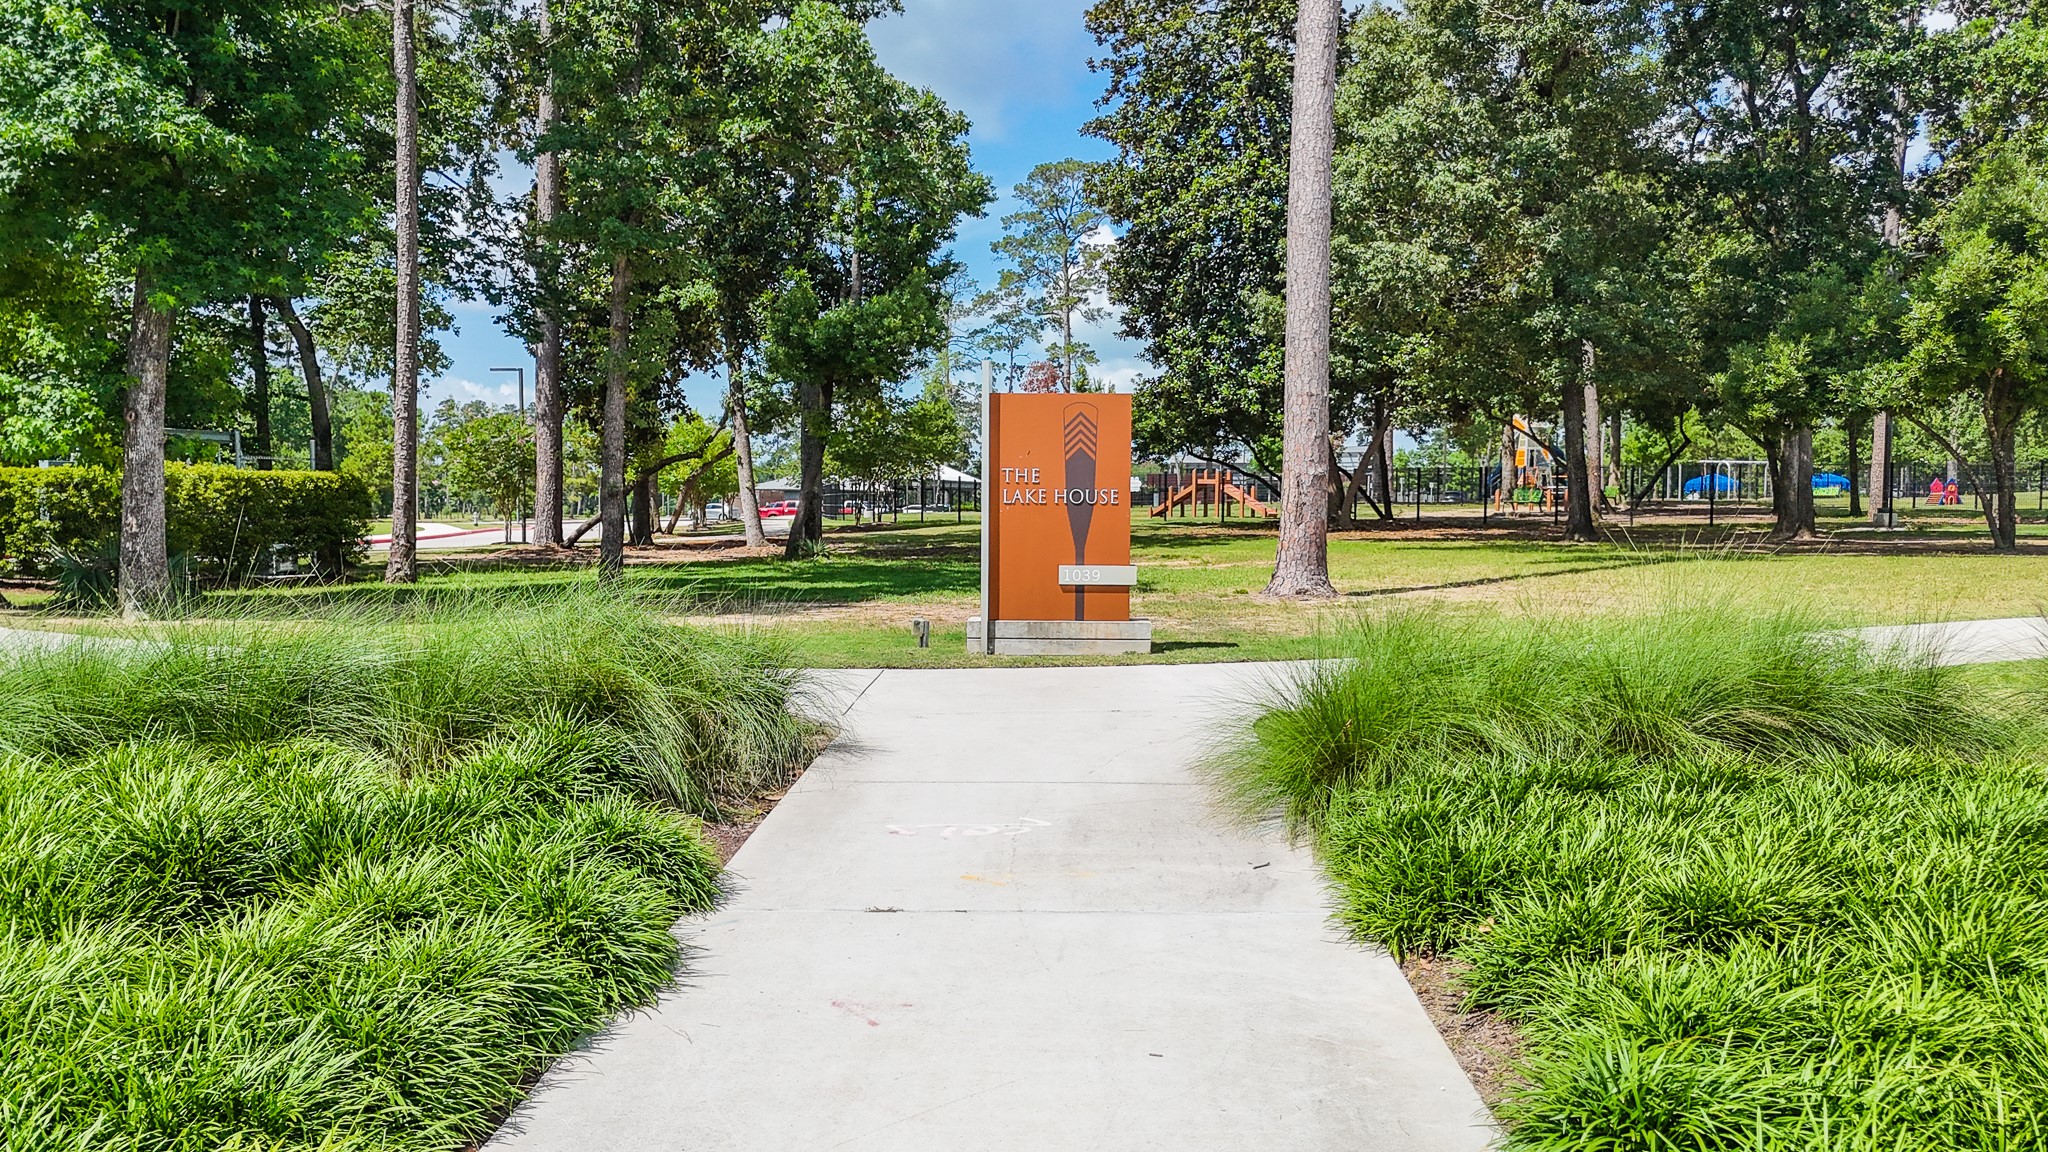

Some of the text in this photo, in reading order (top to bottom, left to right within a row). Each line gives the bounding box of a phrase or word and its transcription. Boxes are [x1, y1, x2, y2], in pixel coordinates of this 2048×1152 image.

[1001, 467, 1041, 484] THE
[1002, 488, 1119, 505] LAKE HOUSE
[1063, 569, 1101, 582] 1039
